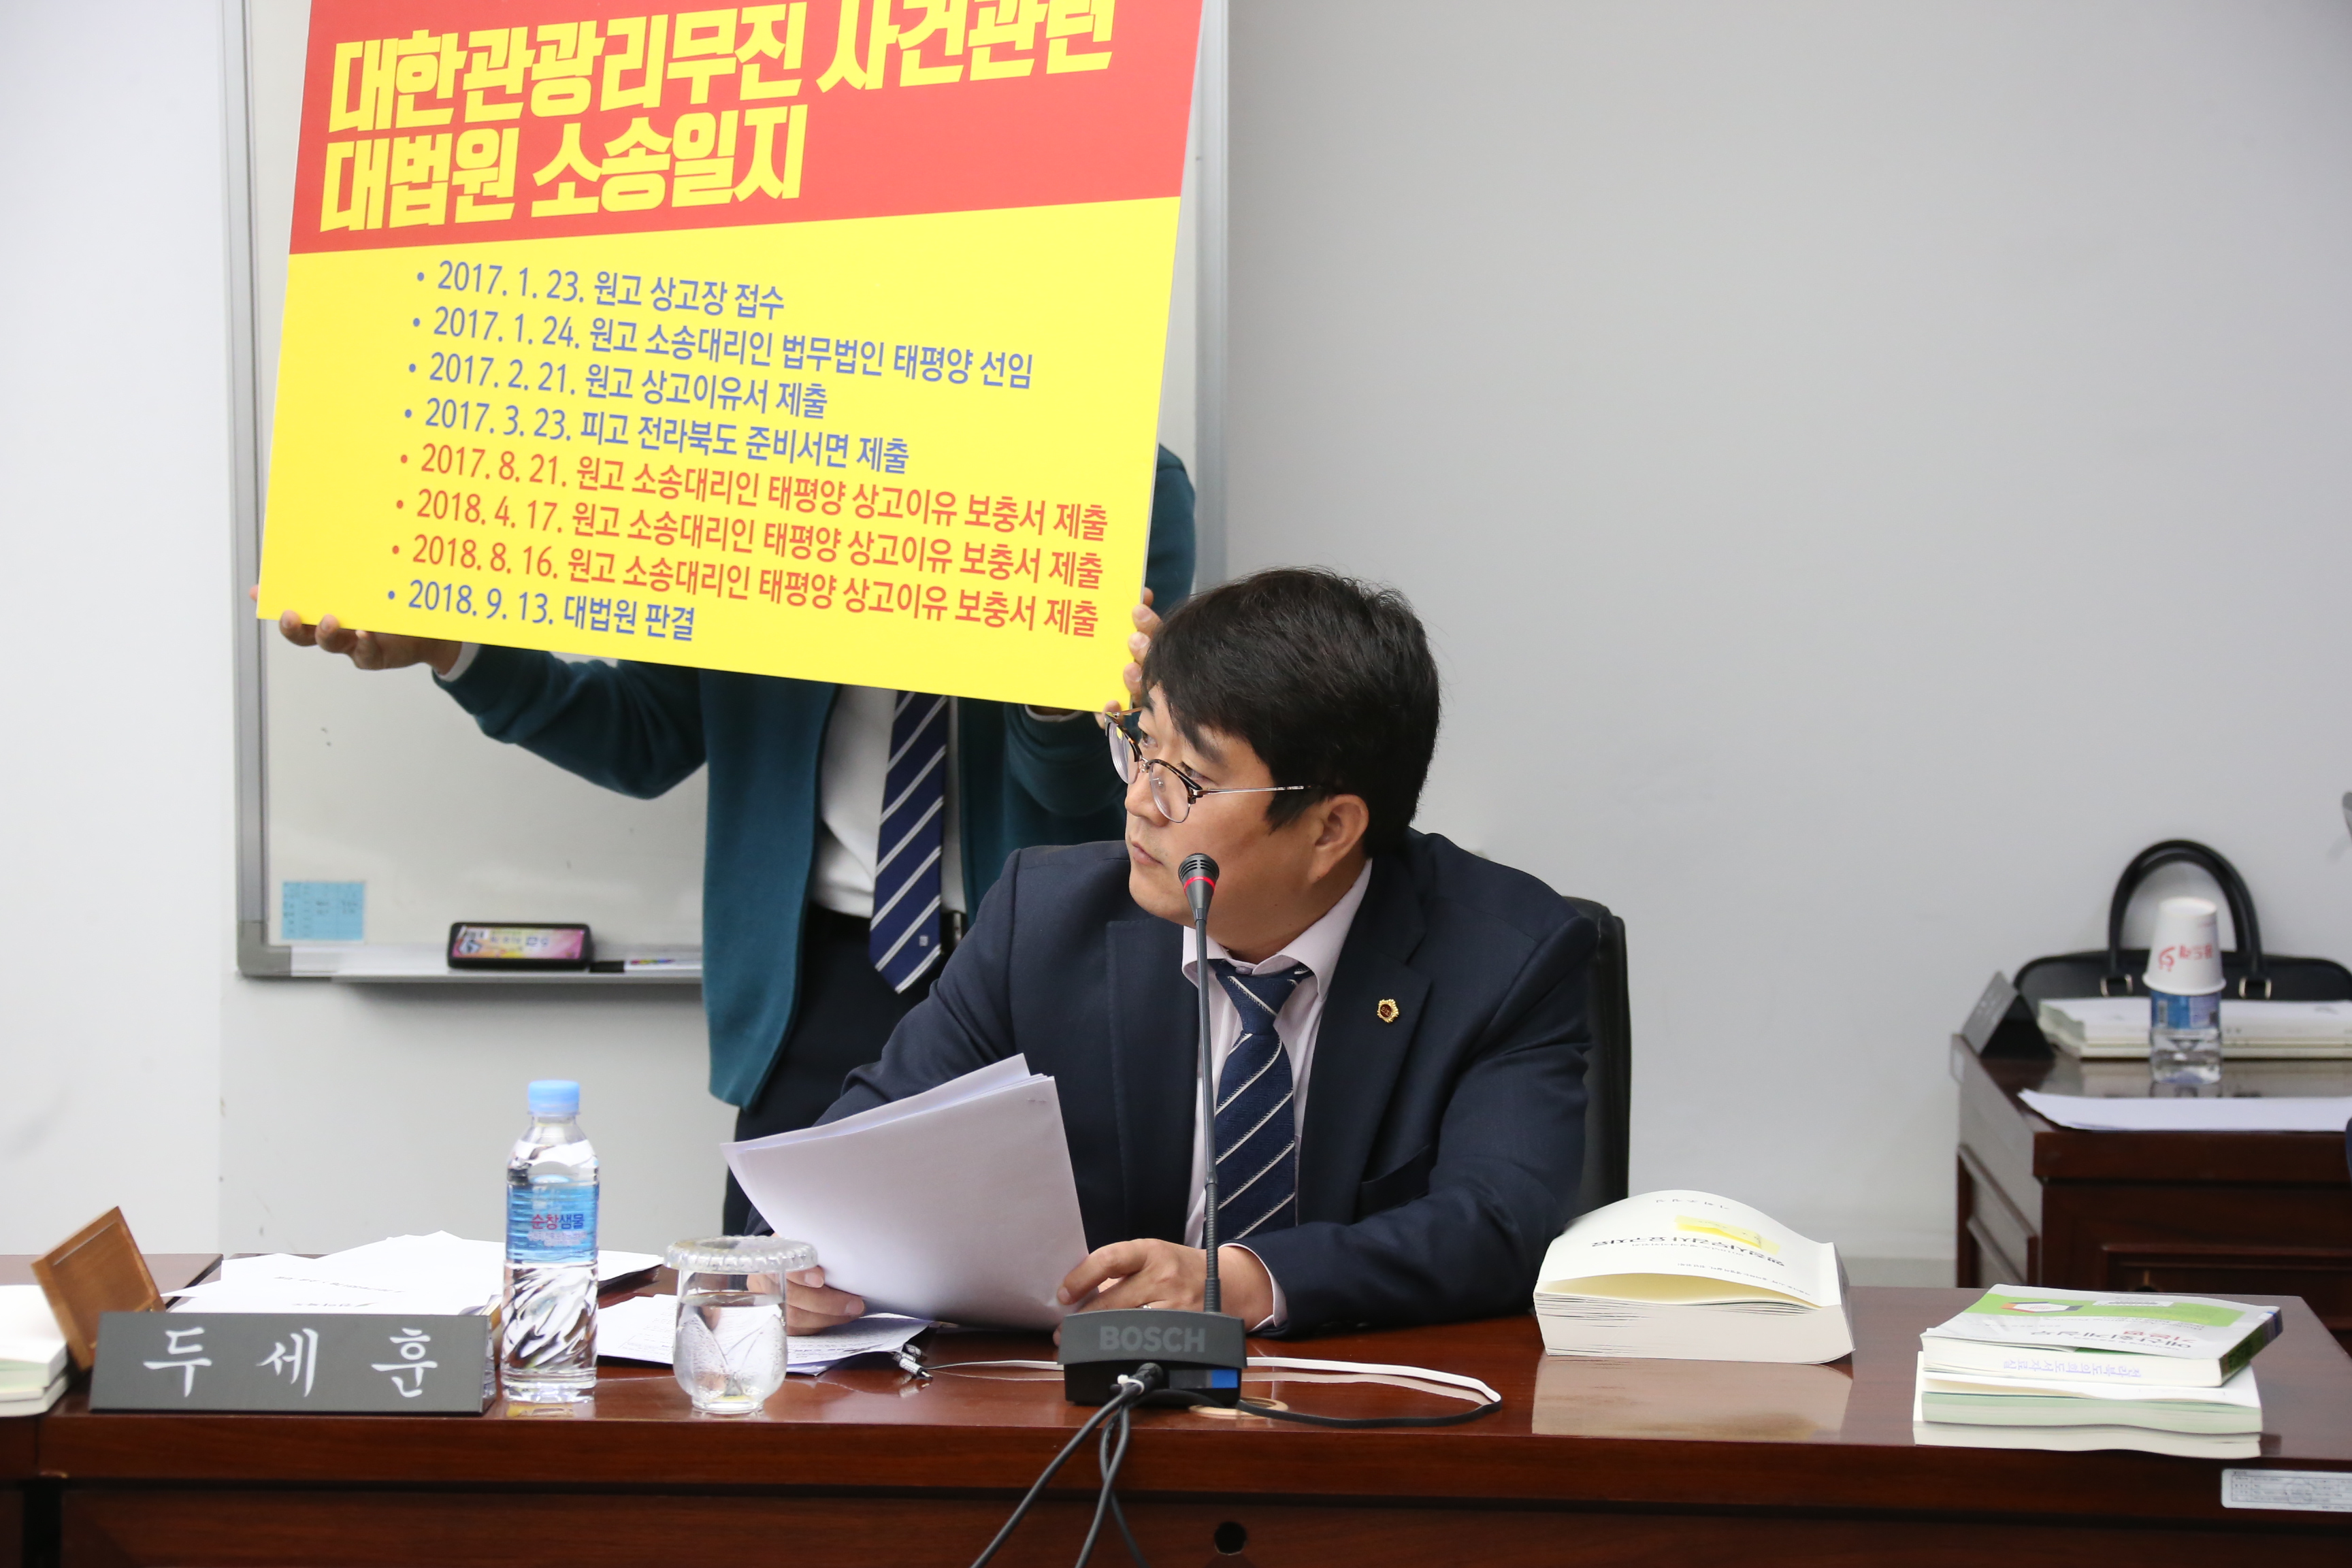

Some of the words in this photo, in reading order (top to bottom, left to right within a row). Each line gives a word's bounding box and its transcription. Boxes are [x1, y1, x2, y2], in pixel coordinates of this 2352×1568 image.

[328, 1, 807, 133] 대한관광리무진
[816, 0, 1116, 93] 사건관련
[320, 127, 519, 232] 대법원
[531, 103, 808, 218] 소송일지
[438, 260, 507, 295] 2017.
[520, 268, 538, 298] 1.
[547, 270, 585, 302] 23.
[595, 271, 642, 306] 원고
[651, 277, 728, 315] 상고장
[735, 284, 785, 319] 접수
[430, 353, 499, 388] 2017.
[508, 359, 529, 390] 2.
[538, 362, 575, 395] 21.
[586, 364, 633, 398] 원고
[642, 370, 768, 413] 상고이유서
[776, 382, 828, 419] 제출
[434, 306, 503, 342] 2017.
[516, 314, 533, 344] 1.
[543, 316, 580, 348] 24.
[591, 317, 637, 352] 원고
[646, 324, 773, 366] 소송대리인
[783, 334, 885, 376] 법무법인
[893, 344, 973, 384] 태평양
[980, 351, 1033, 389] 선임
[426, 397, 495, 434] 2017.
[504, 405, 524, 436] 3.
[534, 408, 571, 440] 23.
[581, 411, 628, 444] 피고
[638, 416, 737, 455] 전라북도
[746, 426, 849, 468] 준비서면
[856, 438, 909, 474] 제출
[422, 443, 490, 479] 2017.
[499, 451, 520, 482] 8.
[529, 454, 566, 487] 21.
[576, 457, 623, 491] 원고
[632, 463, 759, 506] 소송대리인
[768, 476, 846, 515] 태평양
[852, 484, 958, 526] 상고이유
[964, 494, 1046, 536] 보충서
[1053, 504, 1108, 541] 제출
[417, 489, 486, 525] 2018.
[495, 496, 515, 527] 4.
[528, 500, 561, 533] 17.
[572, 502, 619, 537] 원고
[627, 510, 755, 553] 소송대리인
[764, 523, 841, 562] 태평양
[847, 531, 953, 574] 상고이유
[960, 542, 1041, 583] 보충서
[1048, 551, 1103, 589] 제출
[409, 580, 477, 616] 2018.
[487, 588, 507, 619] 9.
[519, 591, 553, 625] 13.
[564, 595, 637, 634] 대법원
[645, 604, 695, 641] 판결
[413, 534, 482, 570] 2018.
[491, 542, 511, 574] 8.
[524, 546, 557, 578] 16.
[568, 549, 615, 583] 원고
[623, 556, 750, 600] 소송대리인
[759, 570, 836, 609] 태평양
[843, 578, 948, 621] 상고이유
[955, 589, 1036, 631] 보충서
[1043, 599, 1098, 637] 제출
[531, 1213, 585, 1230] 순창샘물
[1099, 1326, 1206, 1353] BOSCH
